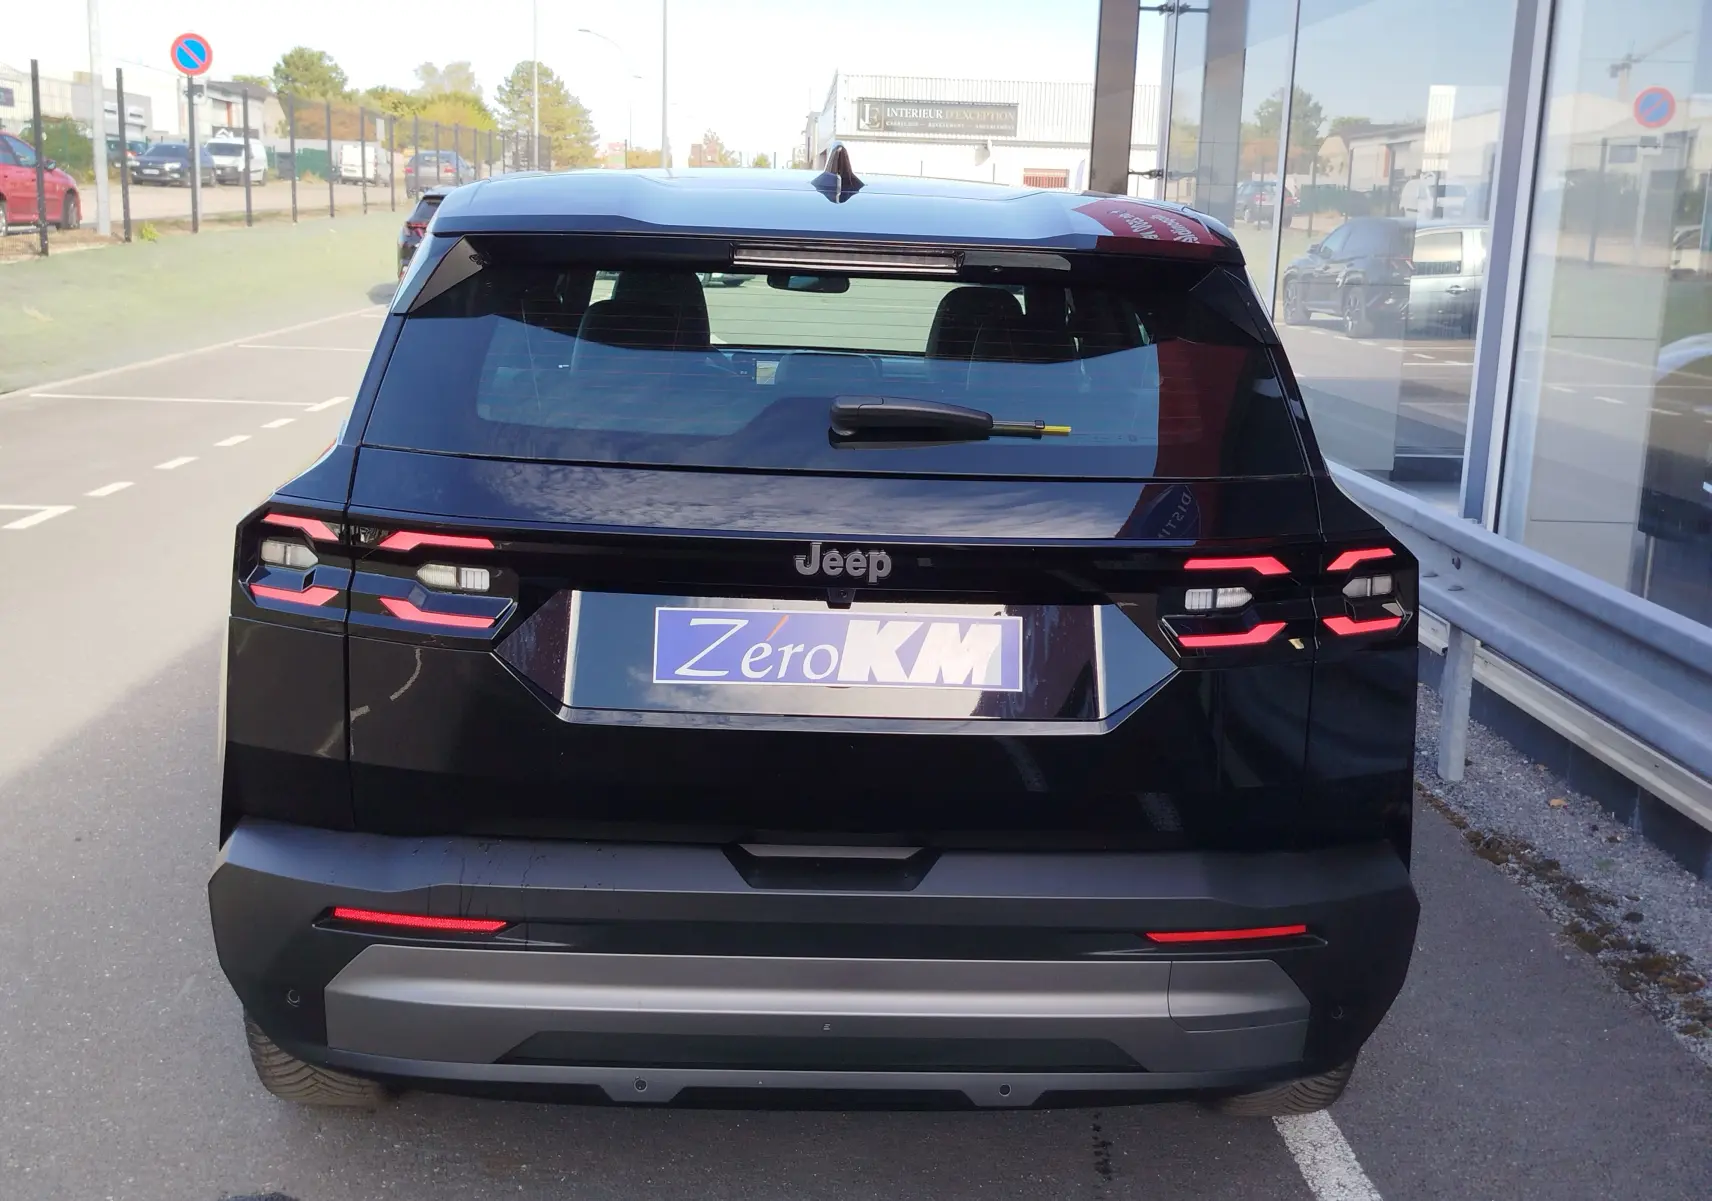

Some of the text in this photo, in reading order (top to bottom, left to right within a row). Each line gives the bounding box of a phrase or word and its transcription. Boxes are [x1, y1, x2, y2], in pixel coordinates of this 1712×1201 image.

[886, 107, 1015, 122] INTERIEUR D'EXCEPTION
[794, 541, 892, 583] Jeep
